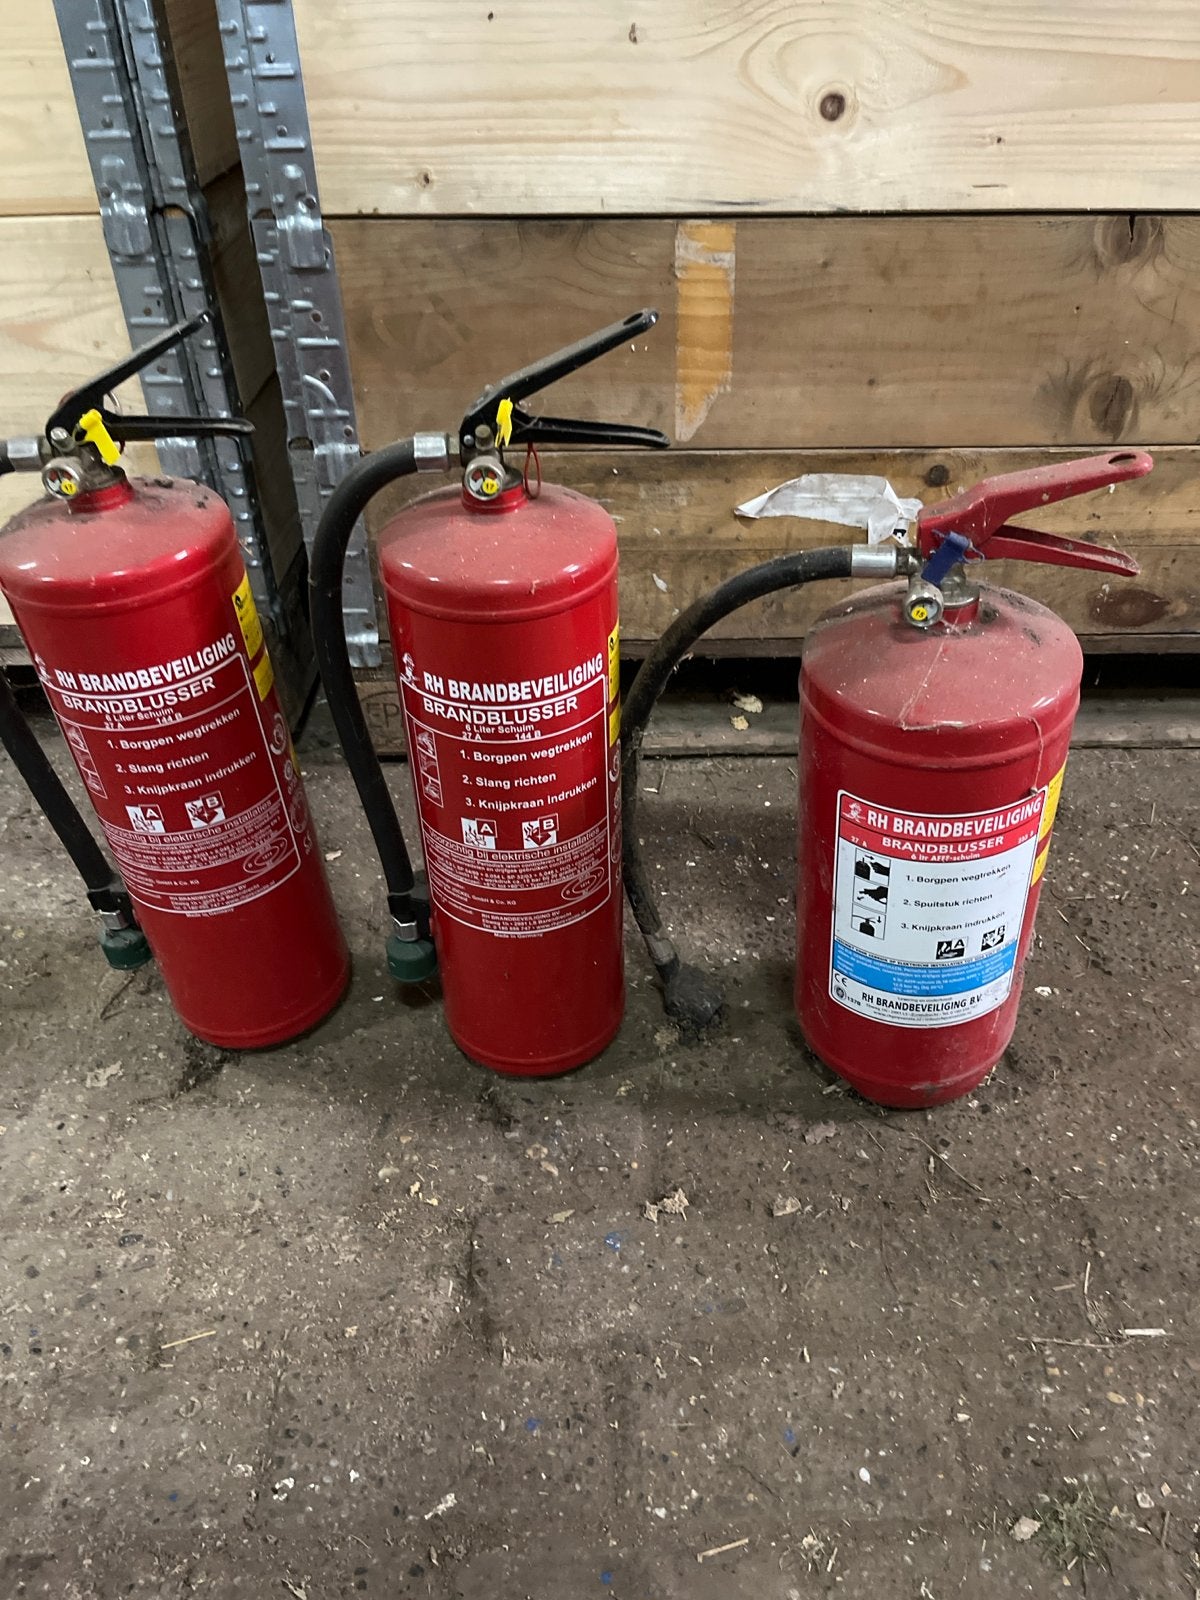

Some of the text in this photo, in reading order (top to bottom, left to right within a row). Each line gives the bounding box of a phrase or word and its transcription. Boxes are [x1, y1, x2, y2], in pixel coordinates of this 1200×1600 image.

[55, 632, 236, 692] RH BRANDBEVEILIGING
[424, 652, 603, 703] RH BRANDBEVEILIGING
[62, 676, 216, 714] BRANDBLUSSER
[112, 713, 134, 722] Liter
[137, 708, 174, 720] Schuim
[423, 697, 578, 725] BRANDBLUSSER
[107, 707, 240, 750] 1. Borgpen wegtrekken
[473, 724, 496, 734] Liter
[498, 724, 534, 734] Schuim
[515, 732, 532, 740] 144
[460, 731, 593, 765] 1. Borgpen wegtrekken
[115, 751, 210, 775] 2. Slang richten
[124, 750, 257, 796] 3. Knijpkraan indrukken
[462, 772, 557, 790] 2. Slang richten
[465, 776, 598, 812] 3. Knijpkraan indrukken
[146, 796, 218, 818] A B
[868, 797, 1042, 838] RH BRANDBEVEILIGING
[164, 826, 221, 843] elektrische
[224, 799, 272, 830] installaties
[480, 818, 555, 834] A B
[476, 851, 489, 861] bij
[492, 848, 551, 861] elektrische
[554, 828, 600, 855] installaties
[882, 836, 1005, 854] BRANDBLUSSER
[906, 864, 1011, 885] 1. Borgpen wegtrekken
[914, 899, 960, 908] Spuitstuk
[962, 894, 993, 906] richten
[912, 924, 962, 932] Knijpkraan
[964, 911, 1006, 928] indrukken
[954, 938, 965, 949] A
[862, 992, 874, 1003] RH
[876, 998, 967, 1012] BRANDBEVEILIGING
